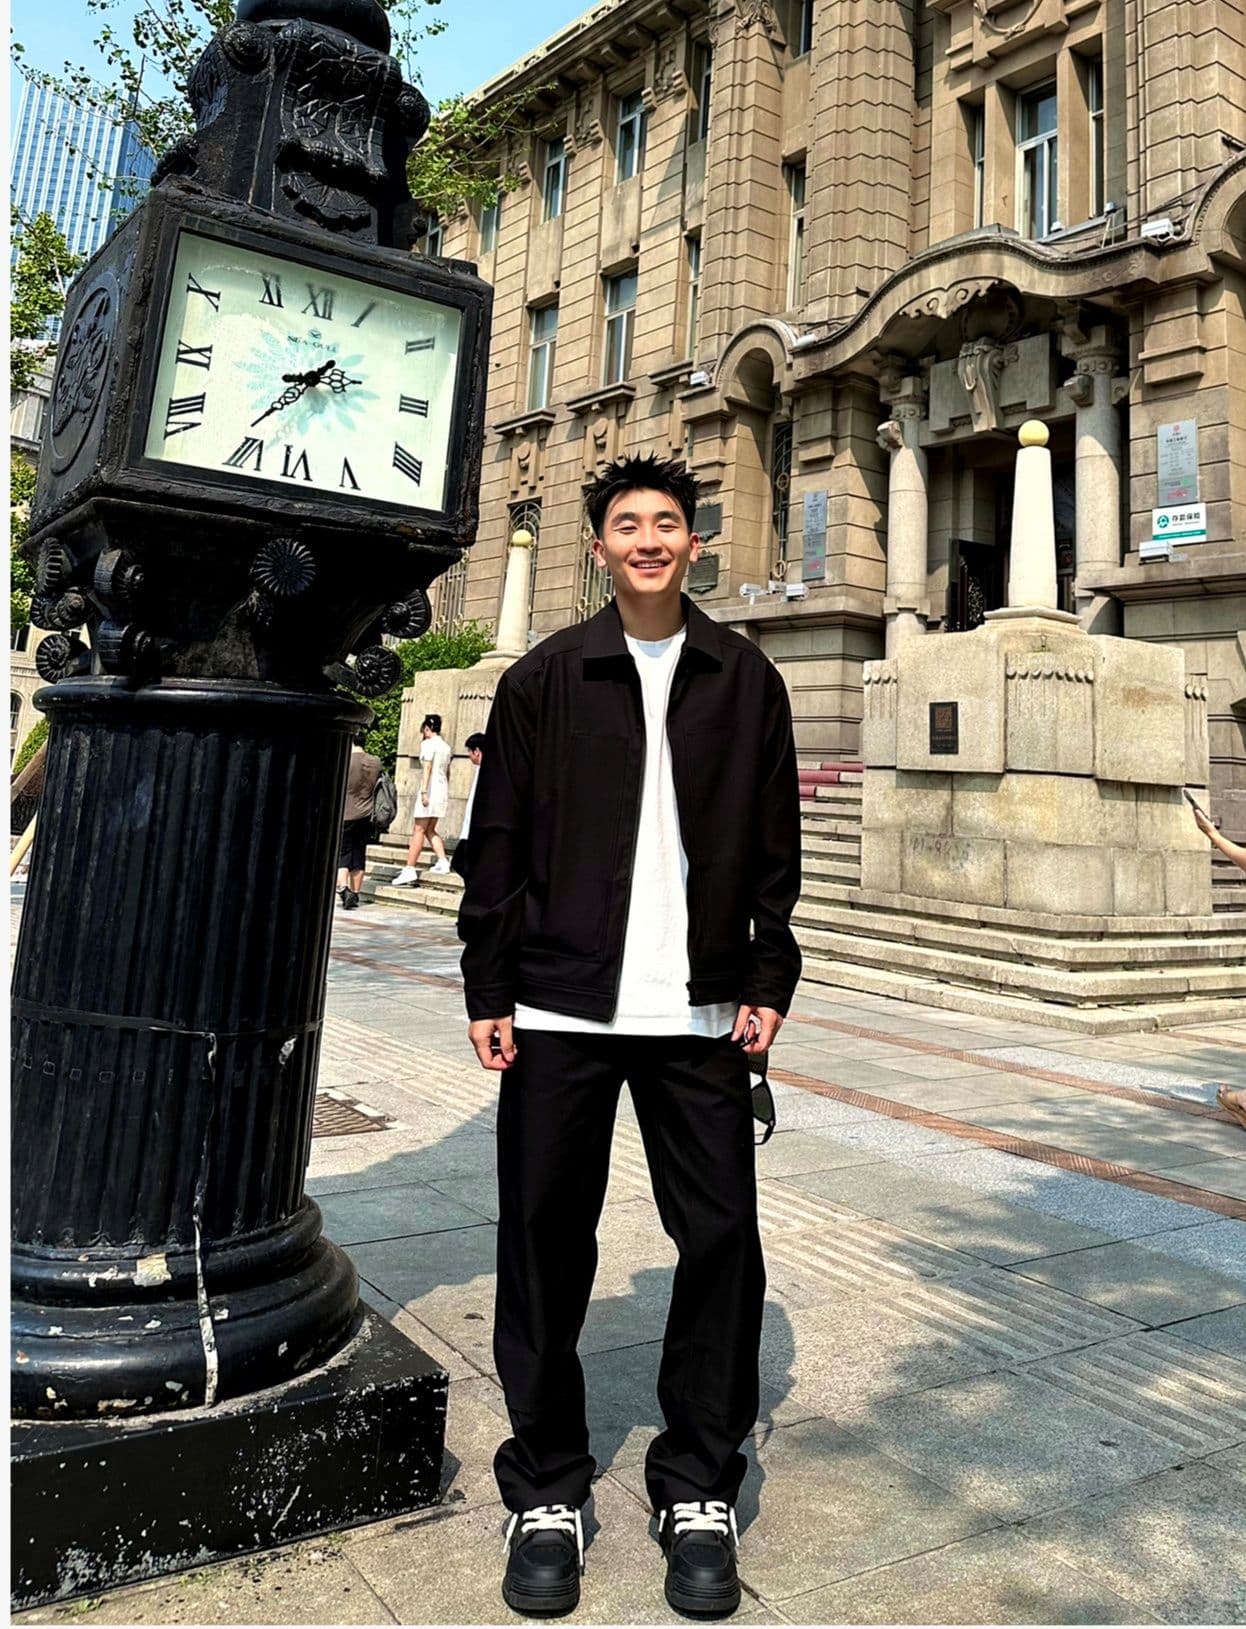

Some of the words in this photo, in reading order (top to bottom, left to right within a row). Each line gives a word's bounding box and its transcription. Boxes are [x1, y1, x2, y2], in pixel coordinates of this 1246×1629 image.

[187, 272, 221, 312] X
[259, 270, 284, 308] XI
[302, 281, 336, 321] XII
[175, 340, 213, 371] IX
[405, 336, 435, 355] II
[163, 392, 206, 440] VIII
[399, 394, 429, 418] III
[222, 436, 264, 472] VII
[280, 444, 313, 482] VI
[339, 456, 361, 491] V
